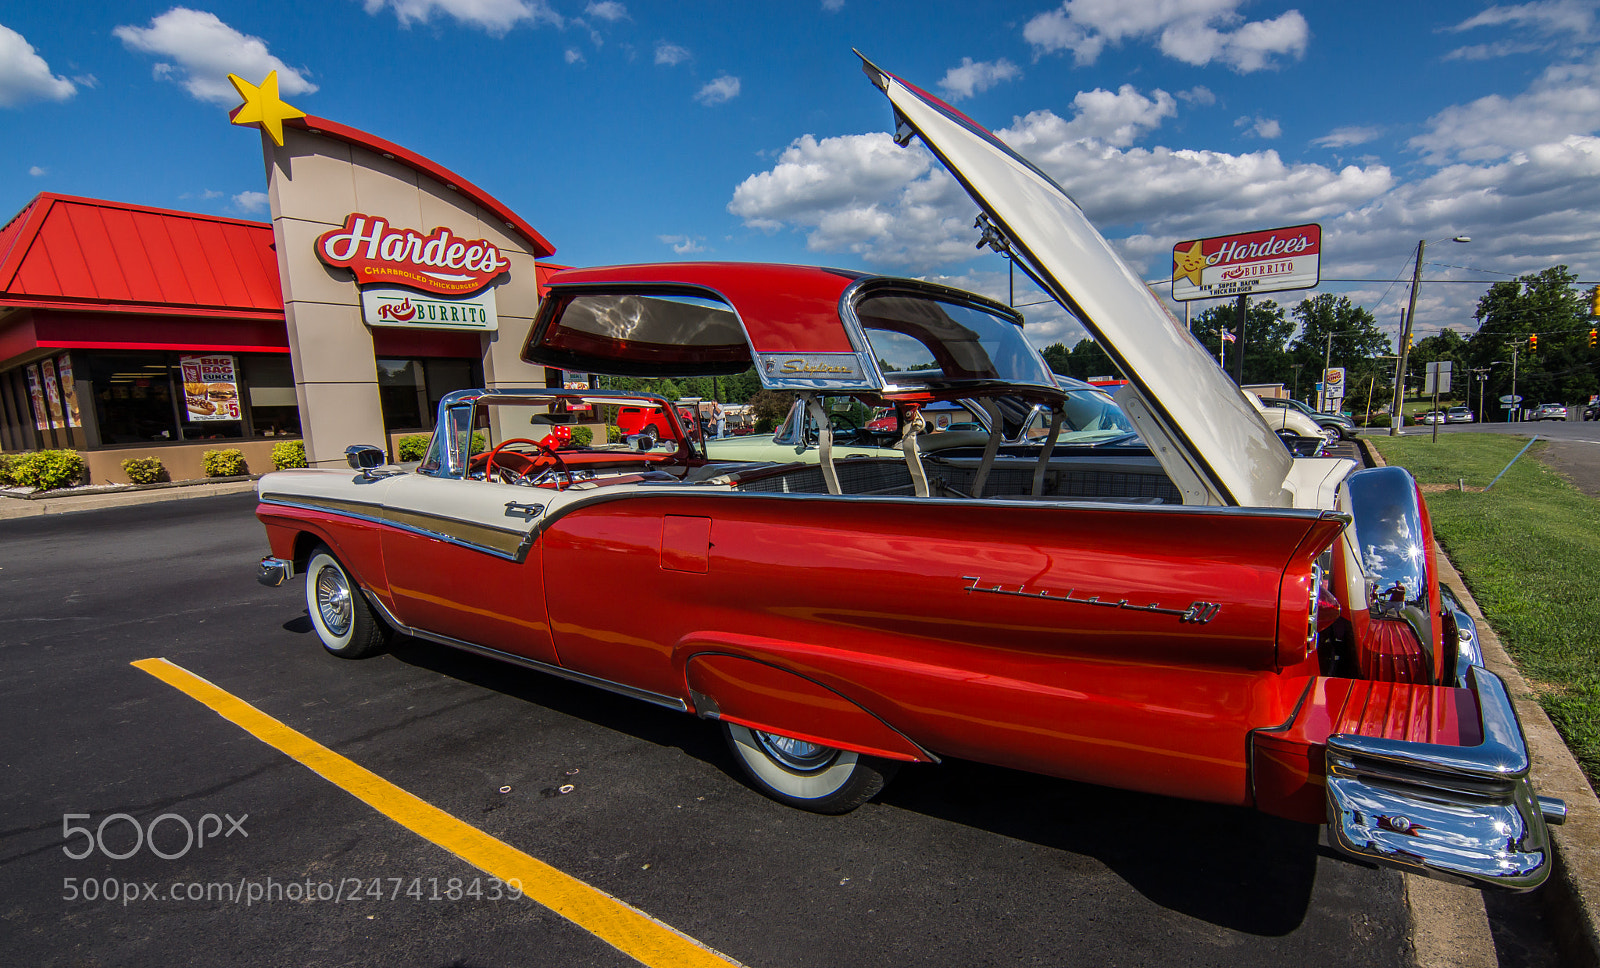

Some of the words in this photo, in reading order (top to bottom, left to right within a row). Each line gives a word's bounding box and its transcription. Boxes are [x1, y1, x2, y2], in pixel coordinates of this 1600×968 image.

[325, 218, 507, 272] Hardee's
[1205, 234, 1314, 265] Hardee's
[364, 266, 427, 283] CHARBROILED
[428, 279, 479, 290] THICKBURGERS
[1221, 265, 1245, 279] Red
[1244, 262, 1293, 276] BURRITO
[1218, 281, 1238, 289] SUPER
[378, 297, 415, 321] Red
[416, 303, 486, 323] BURRITO
[780, 359, 854, 376] Skyliner
